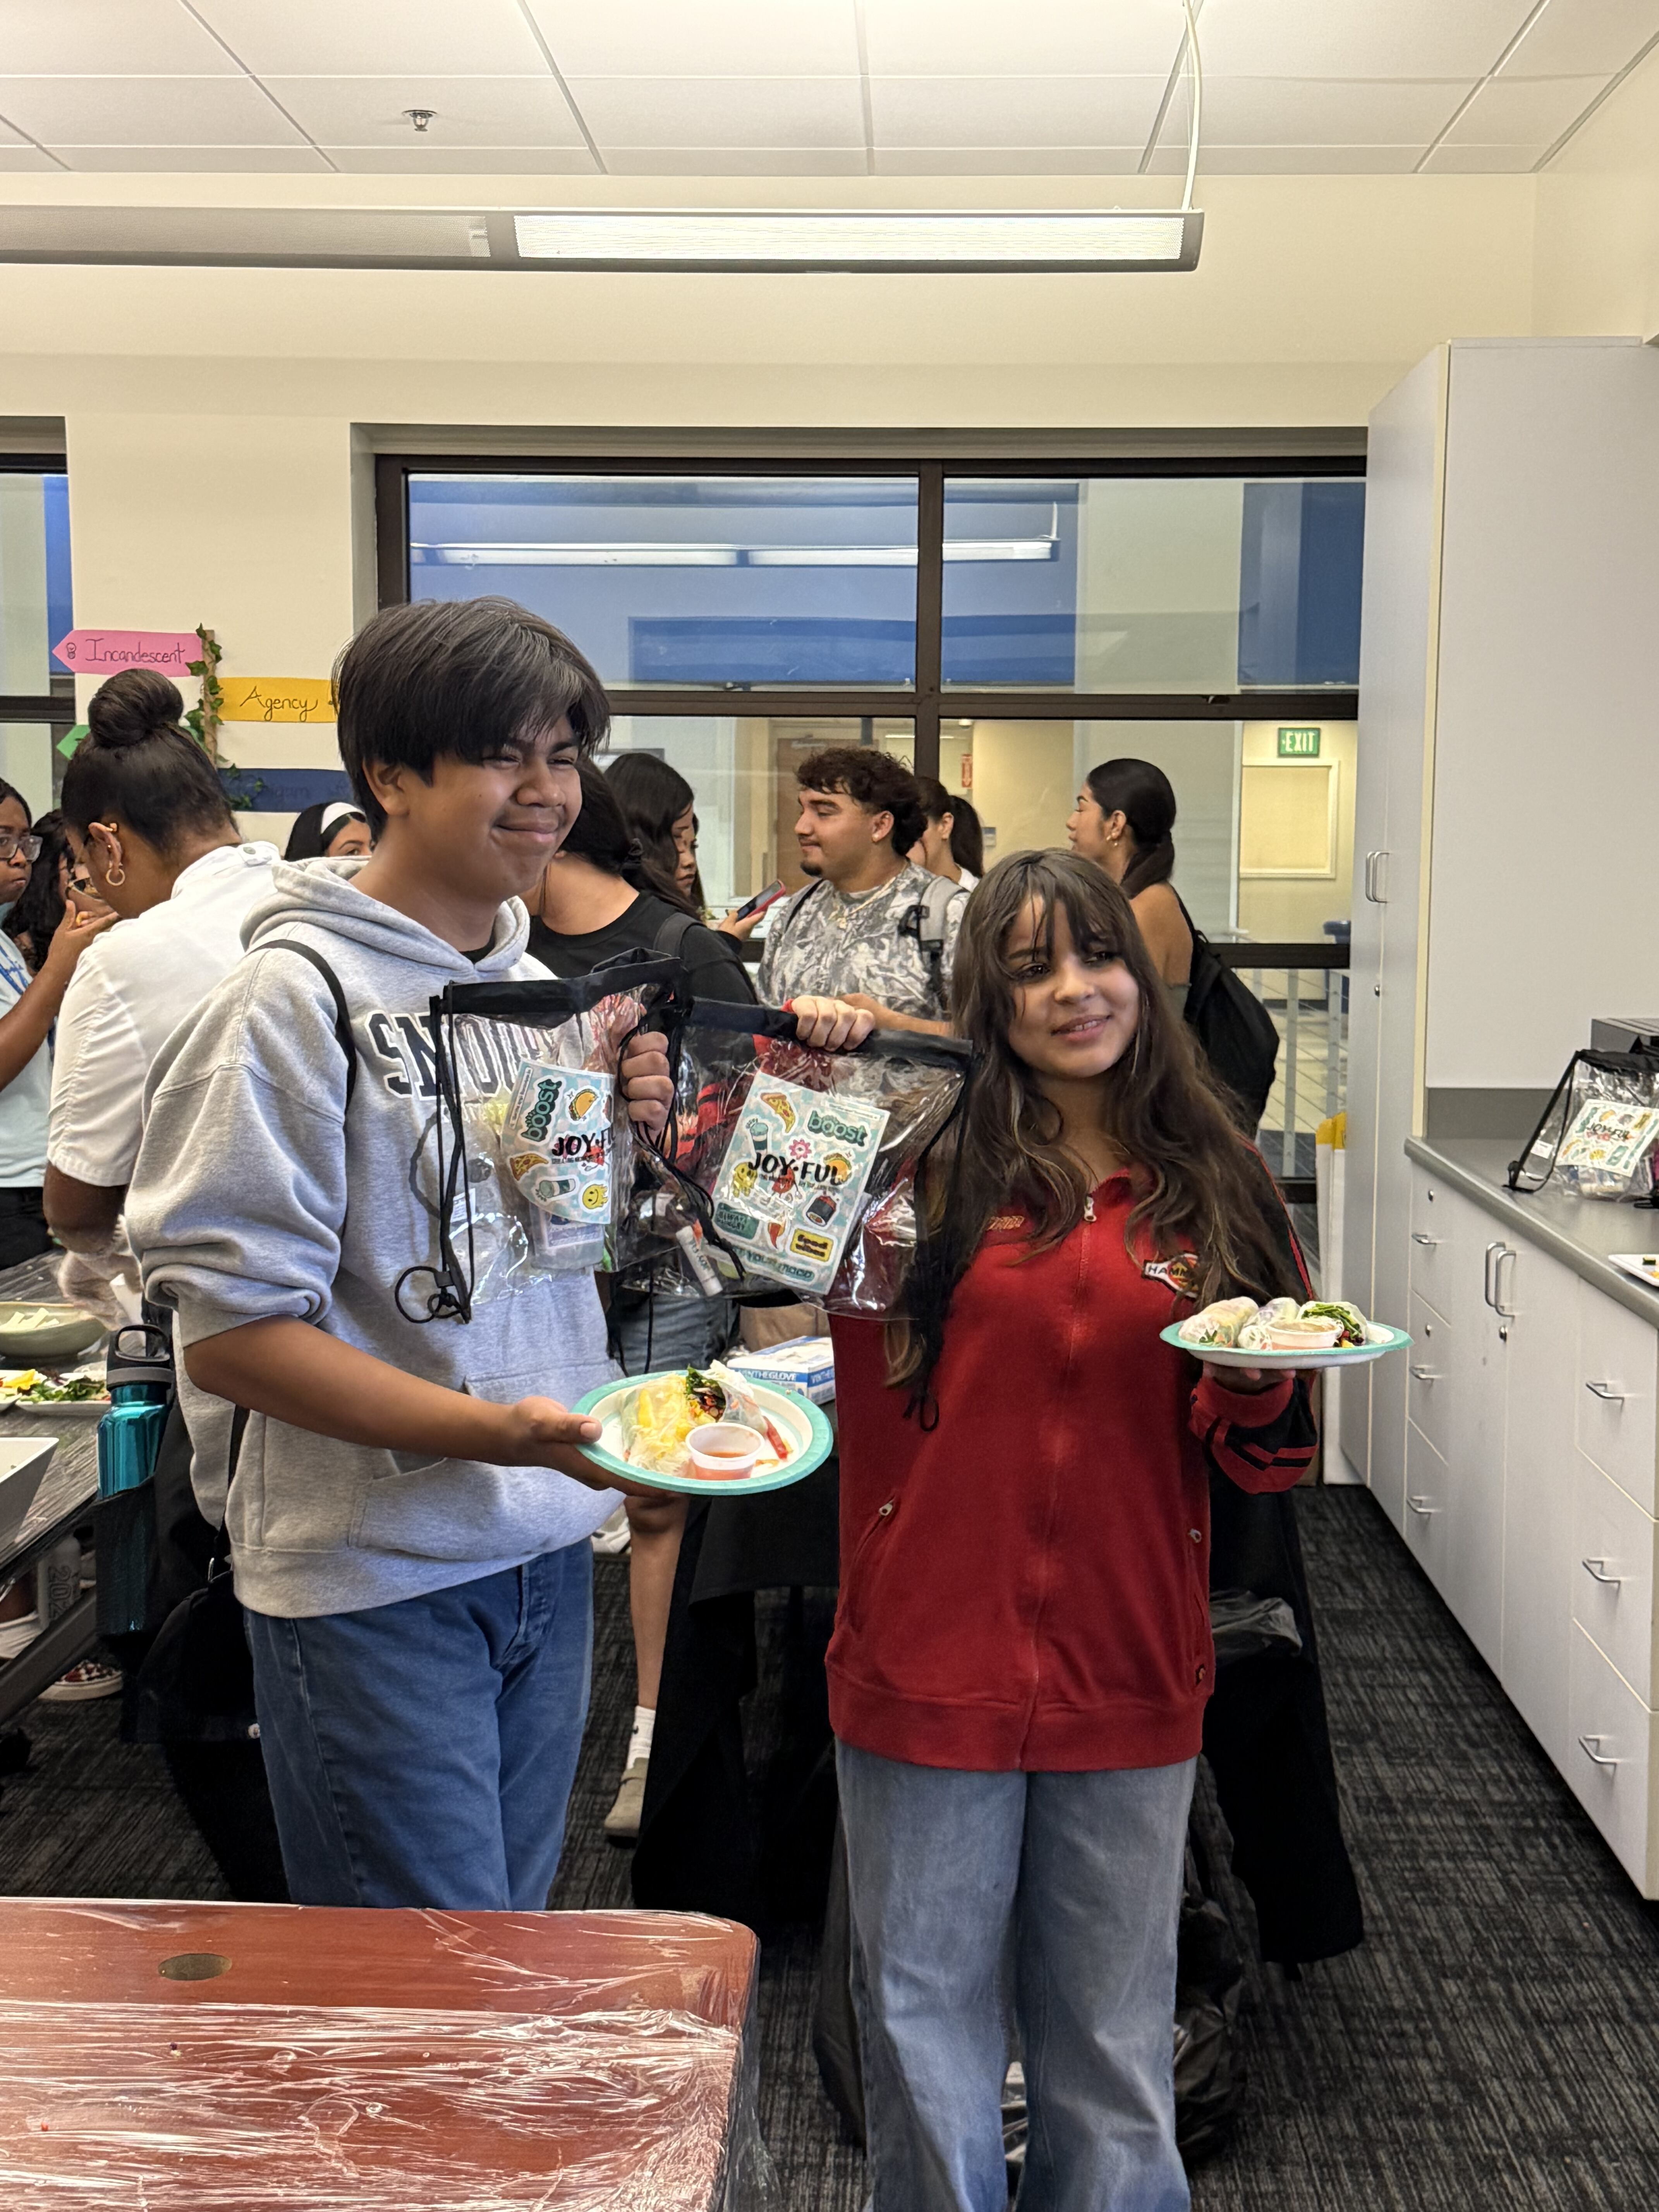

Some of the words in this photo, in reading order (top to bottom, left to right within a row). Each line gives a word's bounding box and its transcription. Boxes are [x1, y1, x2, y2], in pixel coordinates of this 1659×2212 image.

[85, 638, 185, 663] Incandescent
[240, 685, 318, 722] Agency
[1285, 732, 1315, 752] EXIT
[520, 1079, 562, 1142] boost
[807, 1110, 868, 1147] boost
